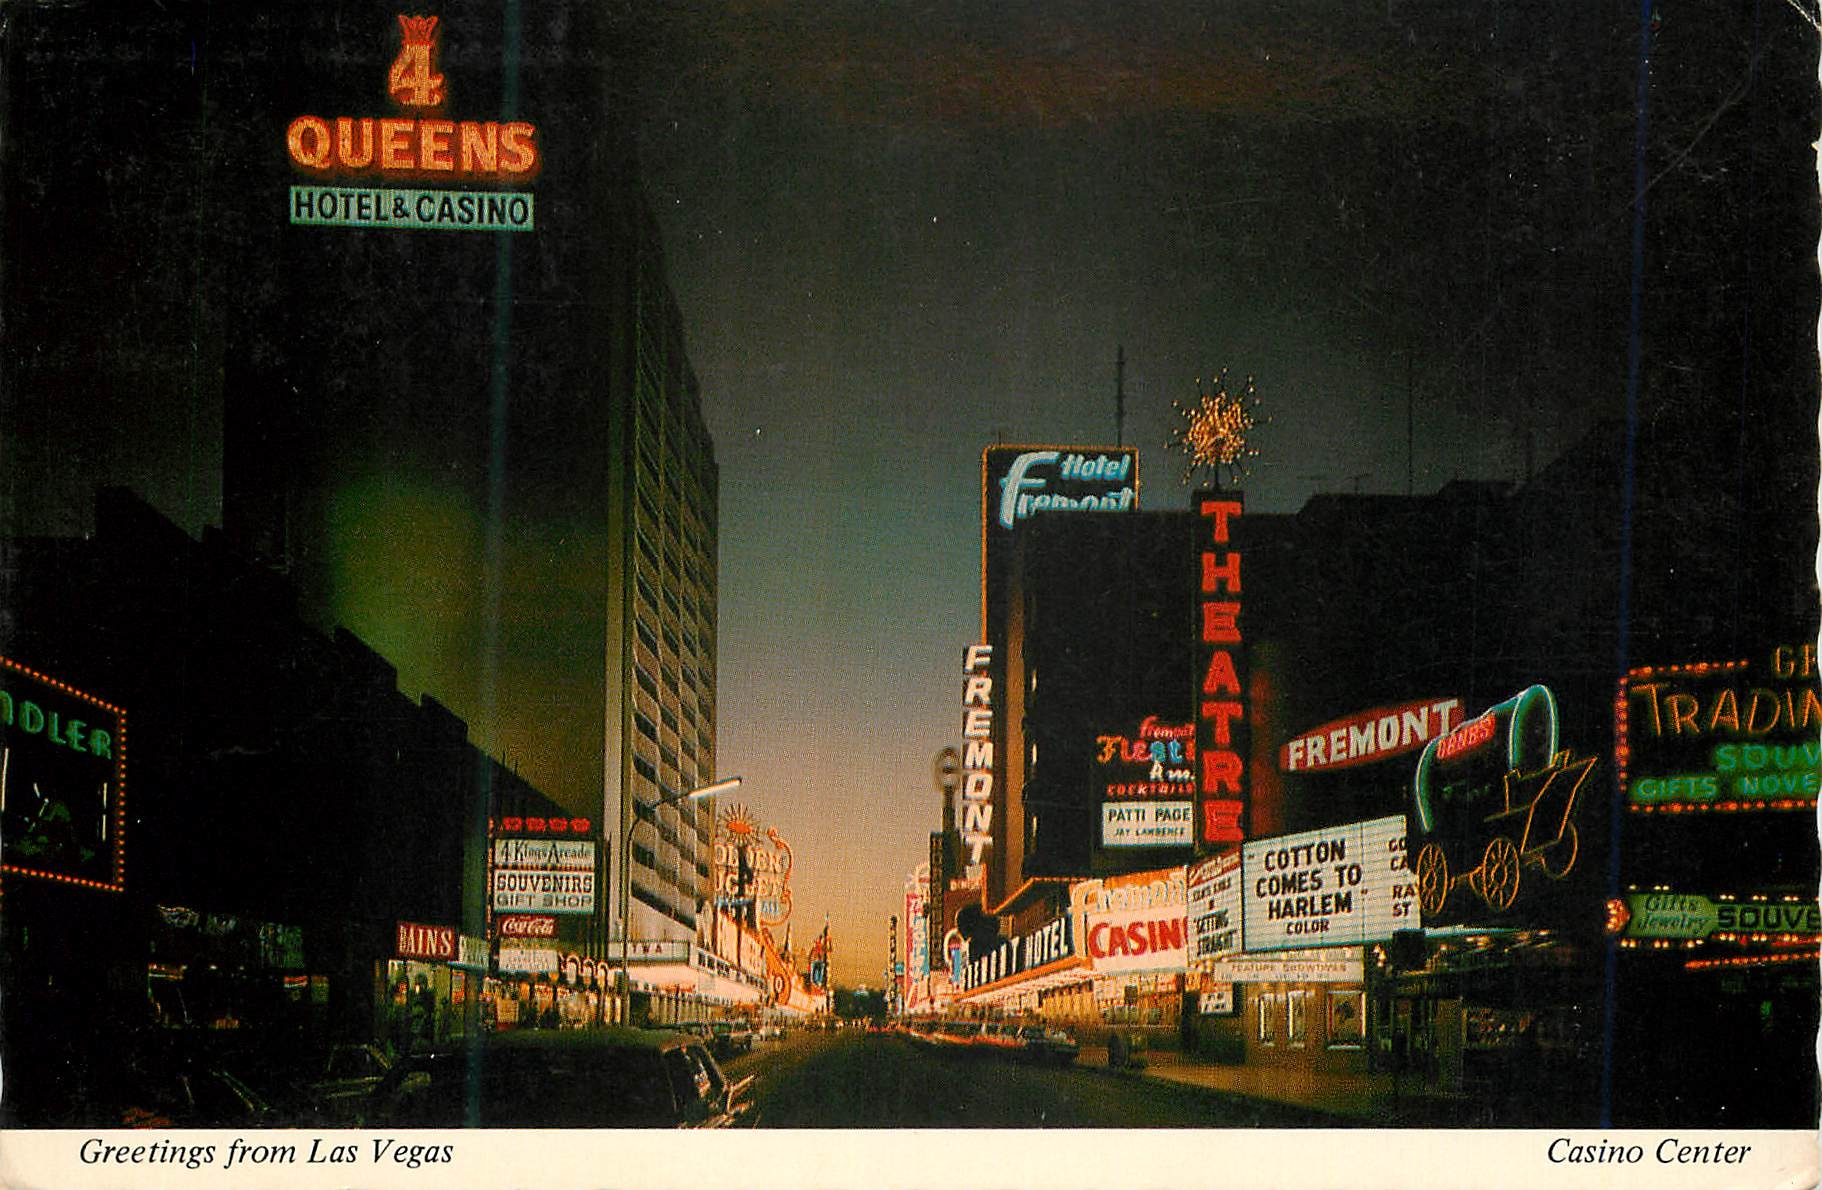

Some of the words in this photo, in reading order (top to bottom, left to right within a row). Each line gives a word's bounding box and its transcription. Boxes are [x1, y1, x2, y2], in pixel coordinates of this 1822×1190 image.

[388, 44, 445, 106] 4
[287, 115, 537, 174] QUEENS
[294, 191, 389, 222] HOTEL
[392, 197, 410, 219] &
[415, 195, 530, 226] CASINO
[1060, 453, 1132, 482] Hotel
[999, 451, 1136, 530] Fremont
[1201, 500, 1244, 842] THEATRE
[1289, 699, 1458, 771] FREMONT
[964, 645, 994, 866] FREMONT
[1637, 776, 1717, 800] GIFTS
[1108, 808, 1145, 822] PATTI
[1155, 808, 1190, 821] PAGE
[1265, 838, 1347, 871] COTTON
[497, 874, 593, 893] SOUVENIRS
[1255, 869, 1323, 898] COMES
[1334, 863, 1362, 888] TO
[497, 893, 536, 907] GIFT
[543, 894, 592, 908] SHOP
[1268, 891, 1353, 921] HARLEM
[1025, 917, 1068, 970] HOTEL
[1286, 918, 1330, 935] COLOR
